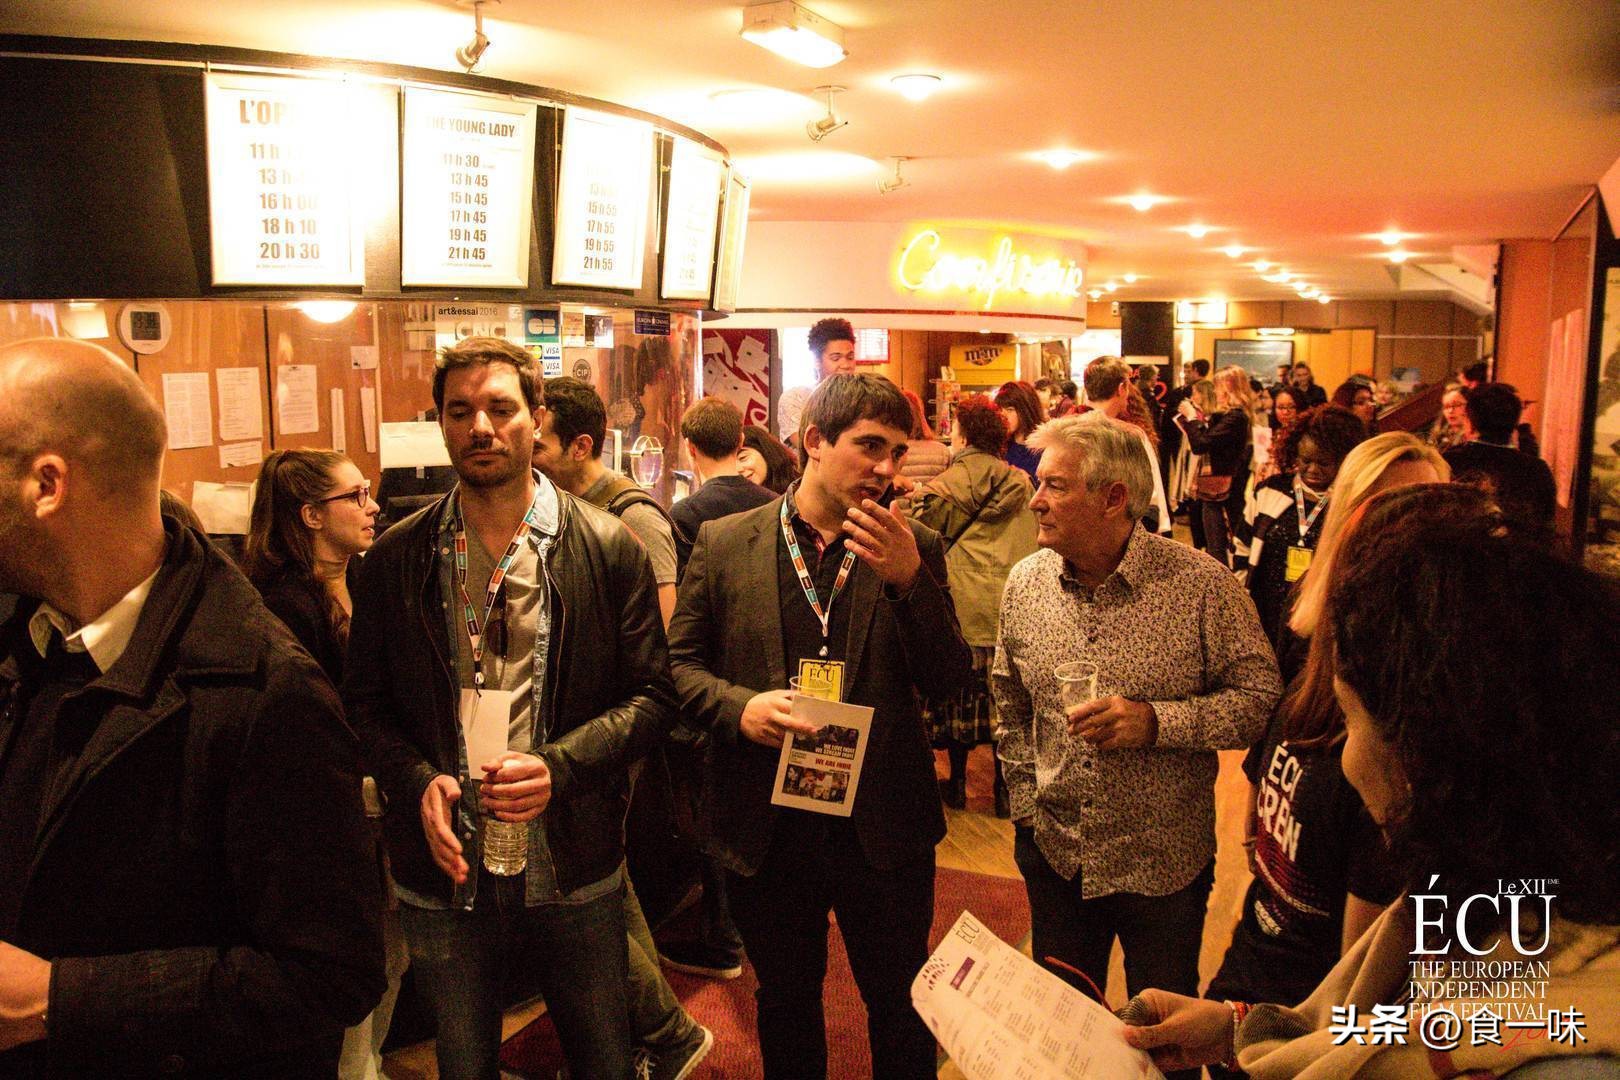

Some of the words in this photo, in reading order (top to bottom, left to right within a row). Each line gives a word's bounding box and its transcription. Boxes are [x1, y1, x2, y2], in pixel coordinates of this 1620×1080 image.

[448, 118, 486, 135] YOUNG
[488, 122, 516, 138] LADY
[465, 154, 480, 168] 30
[450, 172, 462, 185] 13
[465, 173, 472, 186] h
[474, 174, 488, 188] 45
[259, 192, 278, 209] 16
[282, 193, 292, 209] h
[450, 191, 462, 204] 15
[465, 192, 472, 205] h
[474, 193, 488, 206] 45
[451, 209, 461, 222] 17
[463, 210, 471, 223] h
[472, 211, 487, 225] 45
[261, 217, 280, 235] 18
[284, 218, 295, 235] h
[587, 219, 596, 233] 17
[449, 228, 462, 241] 19
[464, 229, 471, 242] h
[473, 229, 487, 243] 45
[259, 241, 281, 259] 20
[285, 241, 296, 259] h
[300, 242, 321, 260] 30
[585, 238, 595, 251] 19
[603, 239, 615, 253] 55
[448, 246, 460, 259] 21
[463, 246, 470, 260] h
[472, 247, 486, 261] 45
[583, 255, 593, 269] 21
[594, 256, 600, 270] h
[602, 257, 613, 271] 55
[545, 346, 560, 355] VISA
[545, 361, 560, 370] VISA
